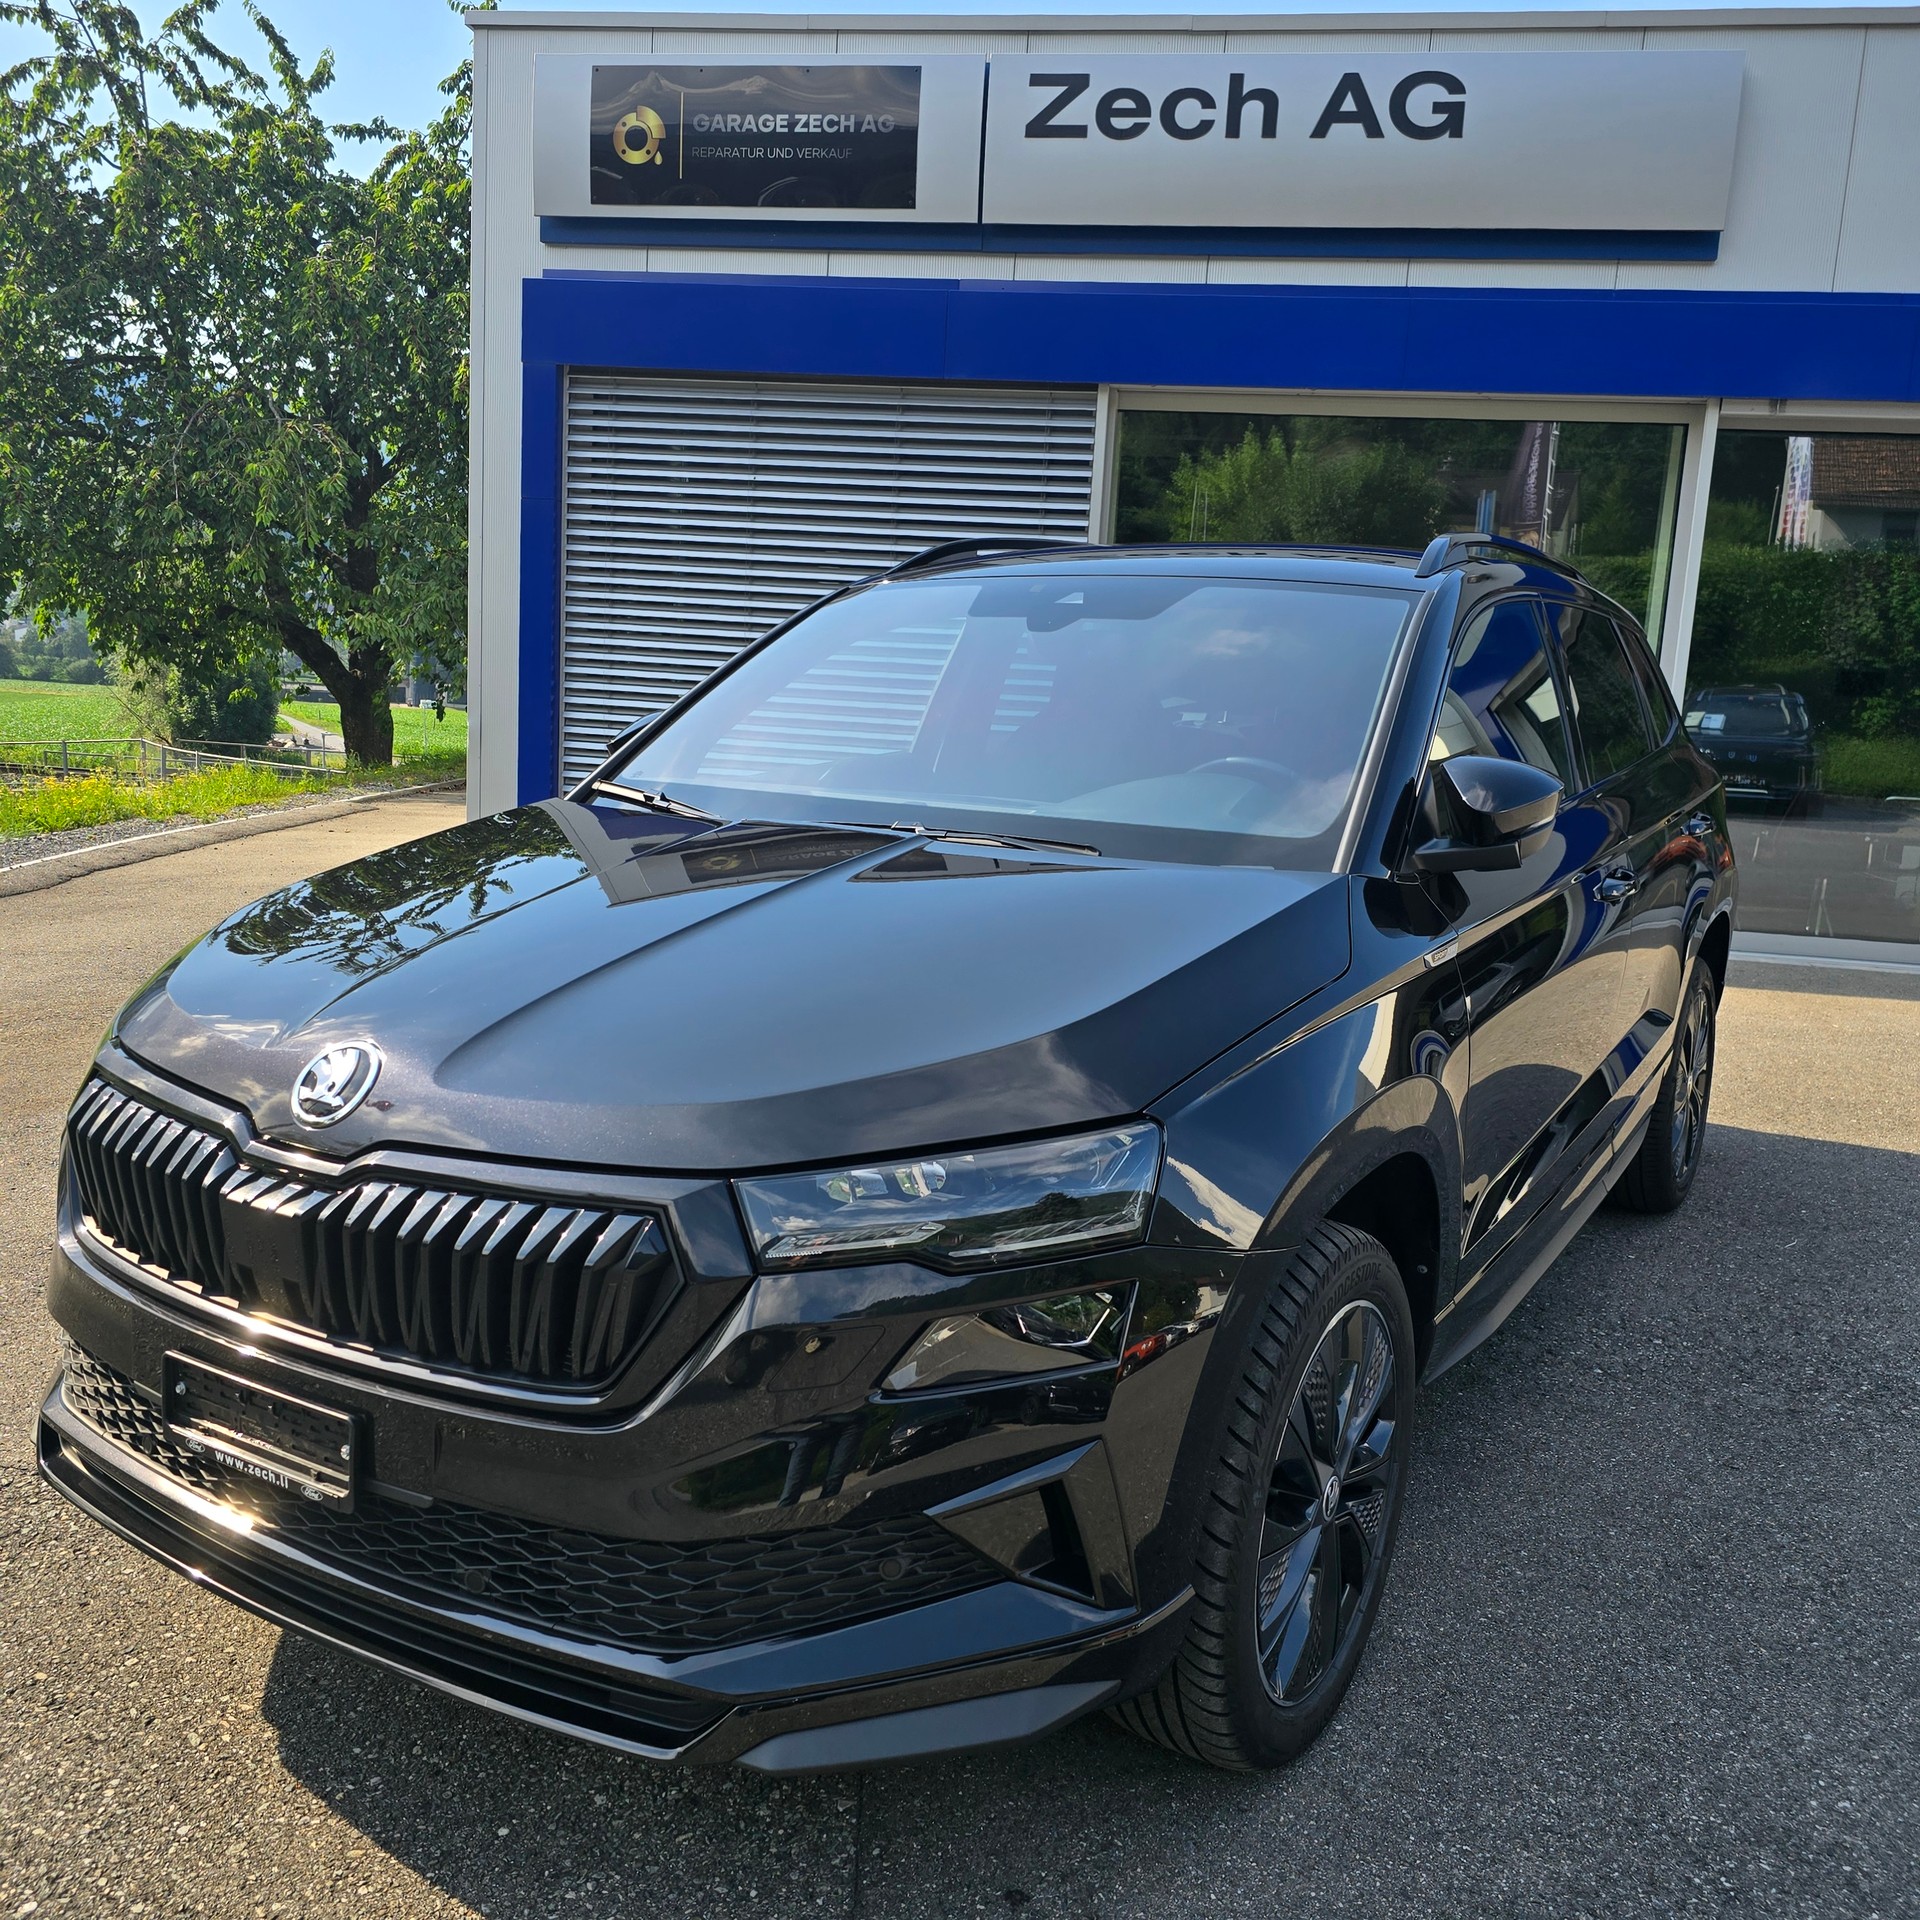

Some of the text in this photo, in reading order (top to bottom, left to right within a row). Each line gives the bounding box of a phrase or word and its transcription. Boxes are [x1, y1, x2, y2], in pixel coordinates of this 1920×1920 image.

[1024, 70, 1467, 140] Zech AG
[692, 113, 895, 134] GARAGE ZECH AG
[691, 147, 853, 160] REPARATUR UND VERKAUF
[214, 1450, 289, 1489] www.zech.li
